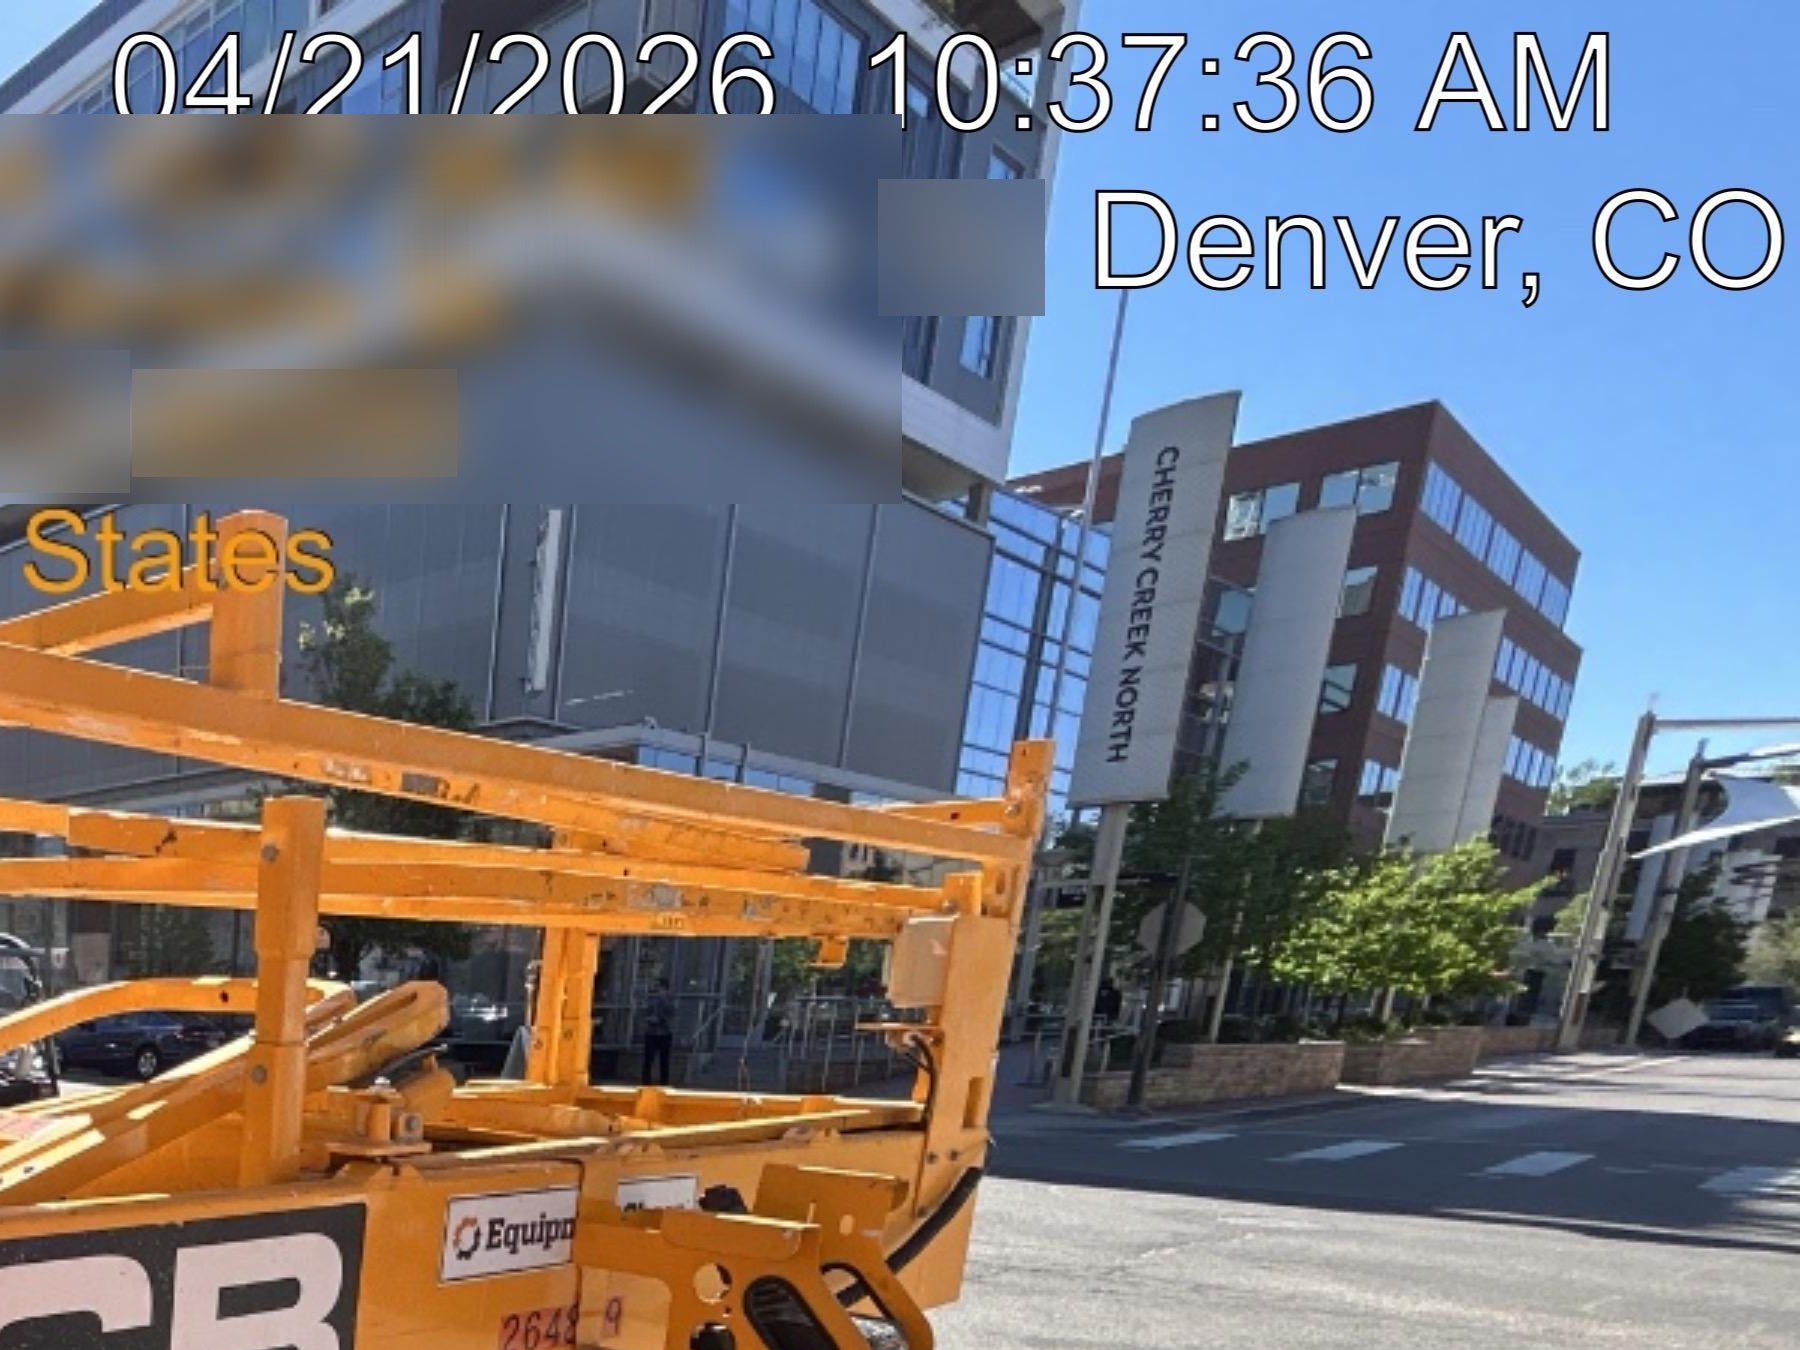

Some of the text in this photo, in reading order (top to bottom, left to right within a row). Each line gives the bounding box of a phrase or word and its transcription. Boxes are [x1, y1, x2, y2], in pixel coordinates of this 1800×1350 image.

[1105, 446, 1180, 763] CHERRY CREEK NORTH
